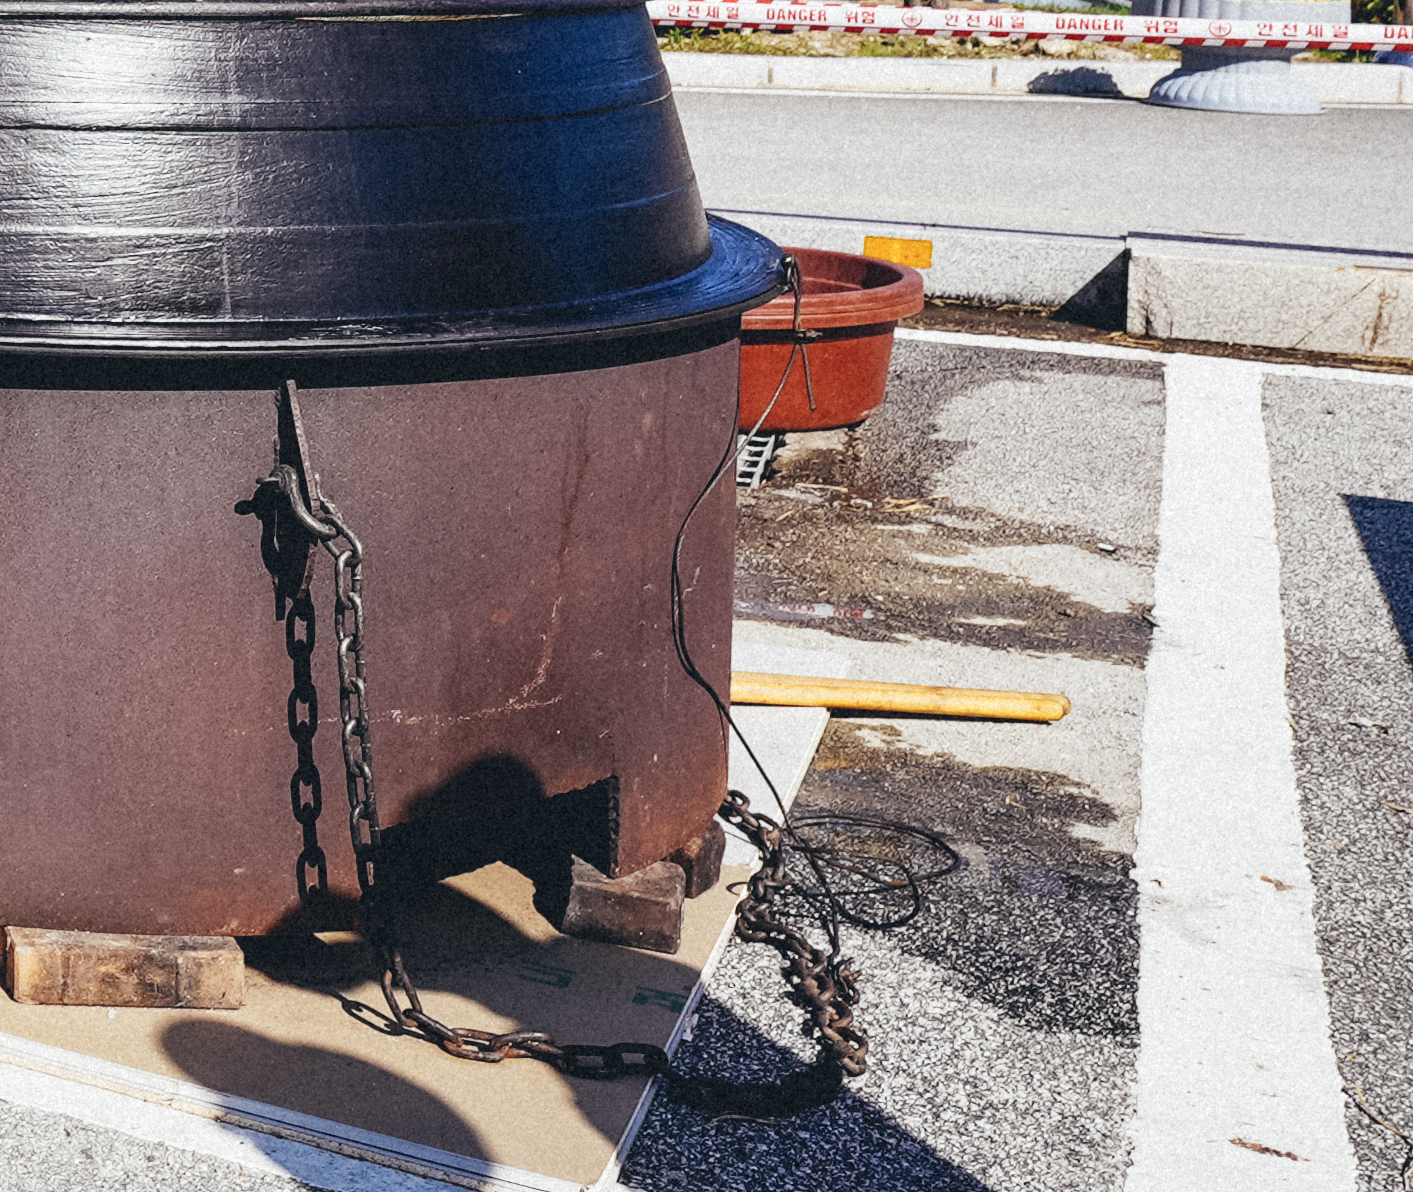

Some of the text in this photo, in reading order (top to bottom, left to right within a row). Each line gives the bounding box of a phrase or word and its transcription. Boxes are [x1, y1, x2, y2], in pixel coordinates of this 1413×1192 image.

[766, 9, 827, 22] DANGER
[845, 11, 875, 24] 위험
[1055, 17, 1124, 31] DANGER
[1145, 19, 1179, 34] 위험
